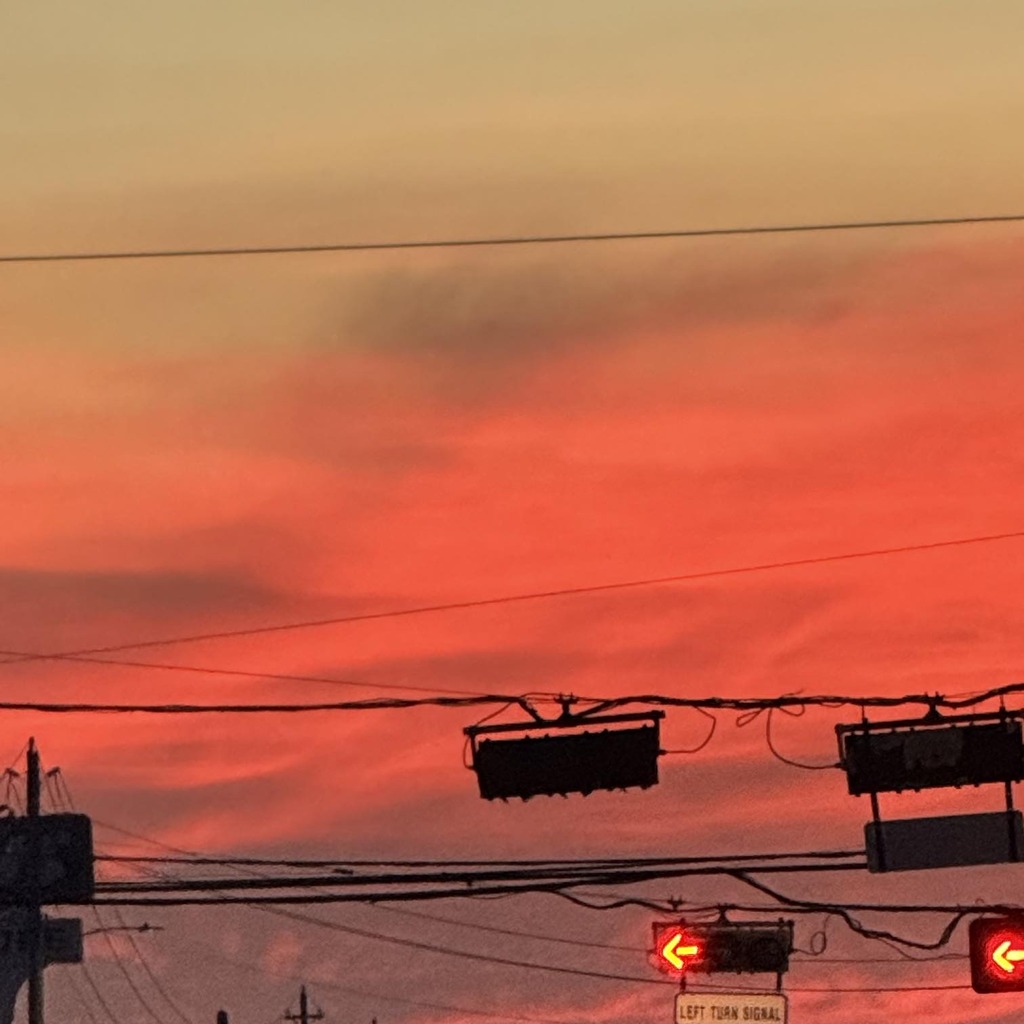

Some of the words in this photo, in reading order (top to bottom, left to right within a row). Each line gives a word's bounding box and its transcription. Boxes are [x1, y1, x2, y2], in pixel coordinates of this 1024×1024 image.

[680, 1006, 705, 1020] LEFT
[711, 1006, 738, 1020] TURN
[743, 1006, 781, 1021] SIGNAL
